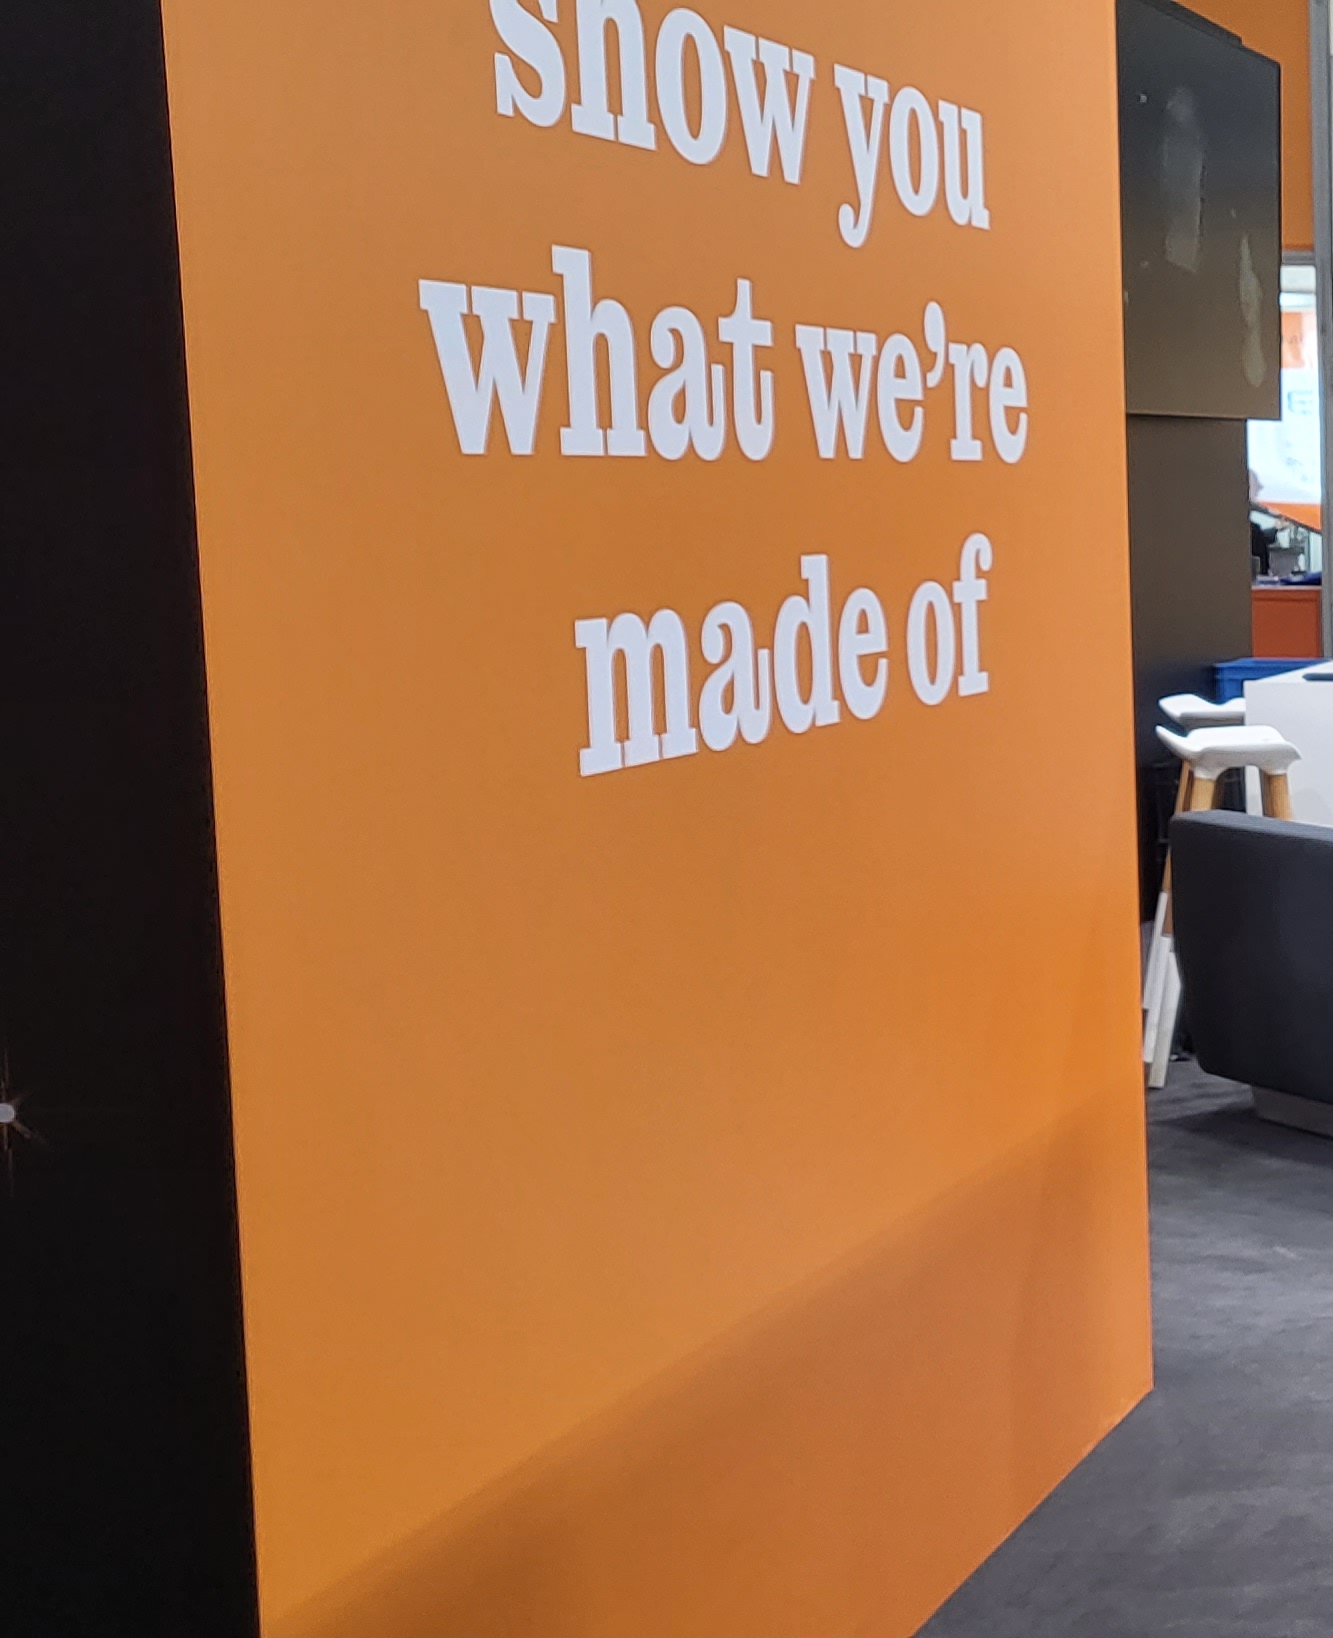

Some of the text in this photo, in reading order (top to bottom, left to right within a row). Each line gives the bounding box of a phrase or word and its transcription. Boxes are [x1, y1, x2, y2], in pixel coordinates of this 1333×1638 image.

[492, 0, 990, 247] show you
[419, 246, 1028, 463] what we're
[576, 533, 990, 777] made of
